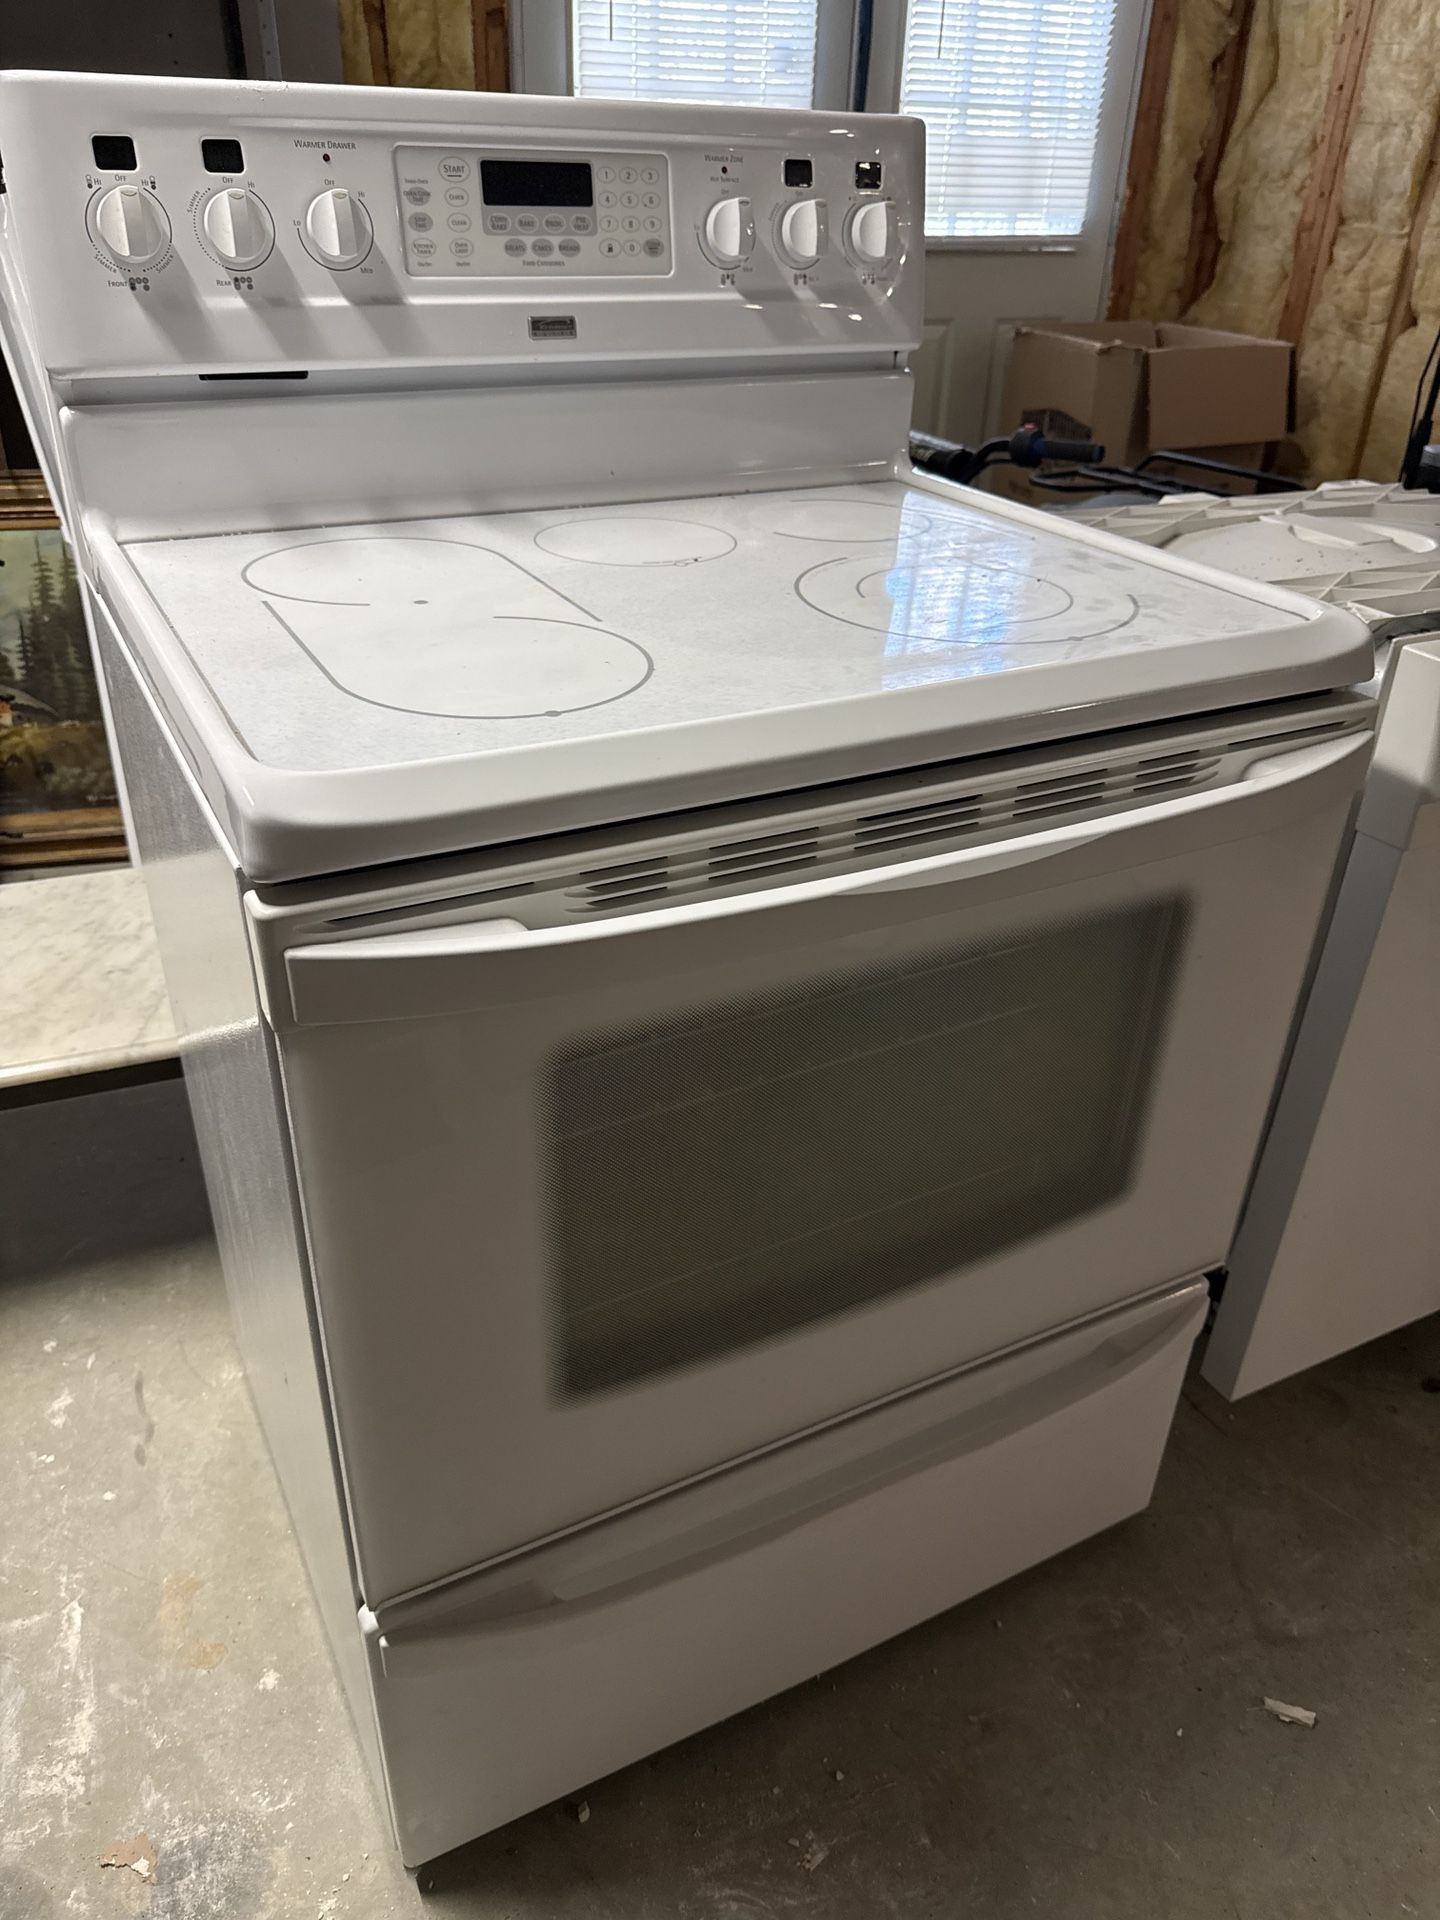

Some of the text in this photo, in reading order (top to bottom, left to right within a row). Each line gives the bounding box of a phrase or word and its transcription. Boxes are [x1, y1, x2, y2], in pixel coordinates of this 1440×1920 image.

[294, 139, 356, 150] WARMER DRAWER
[443, 164, 465, 174] START
